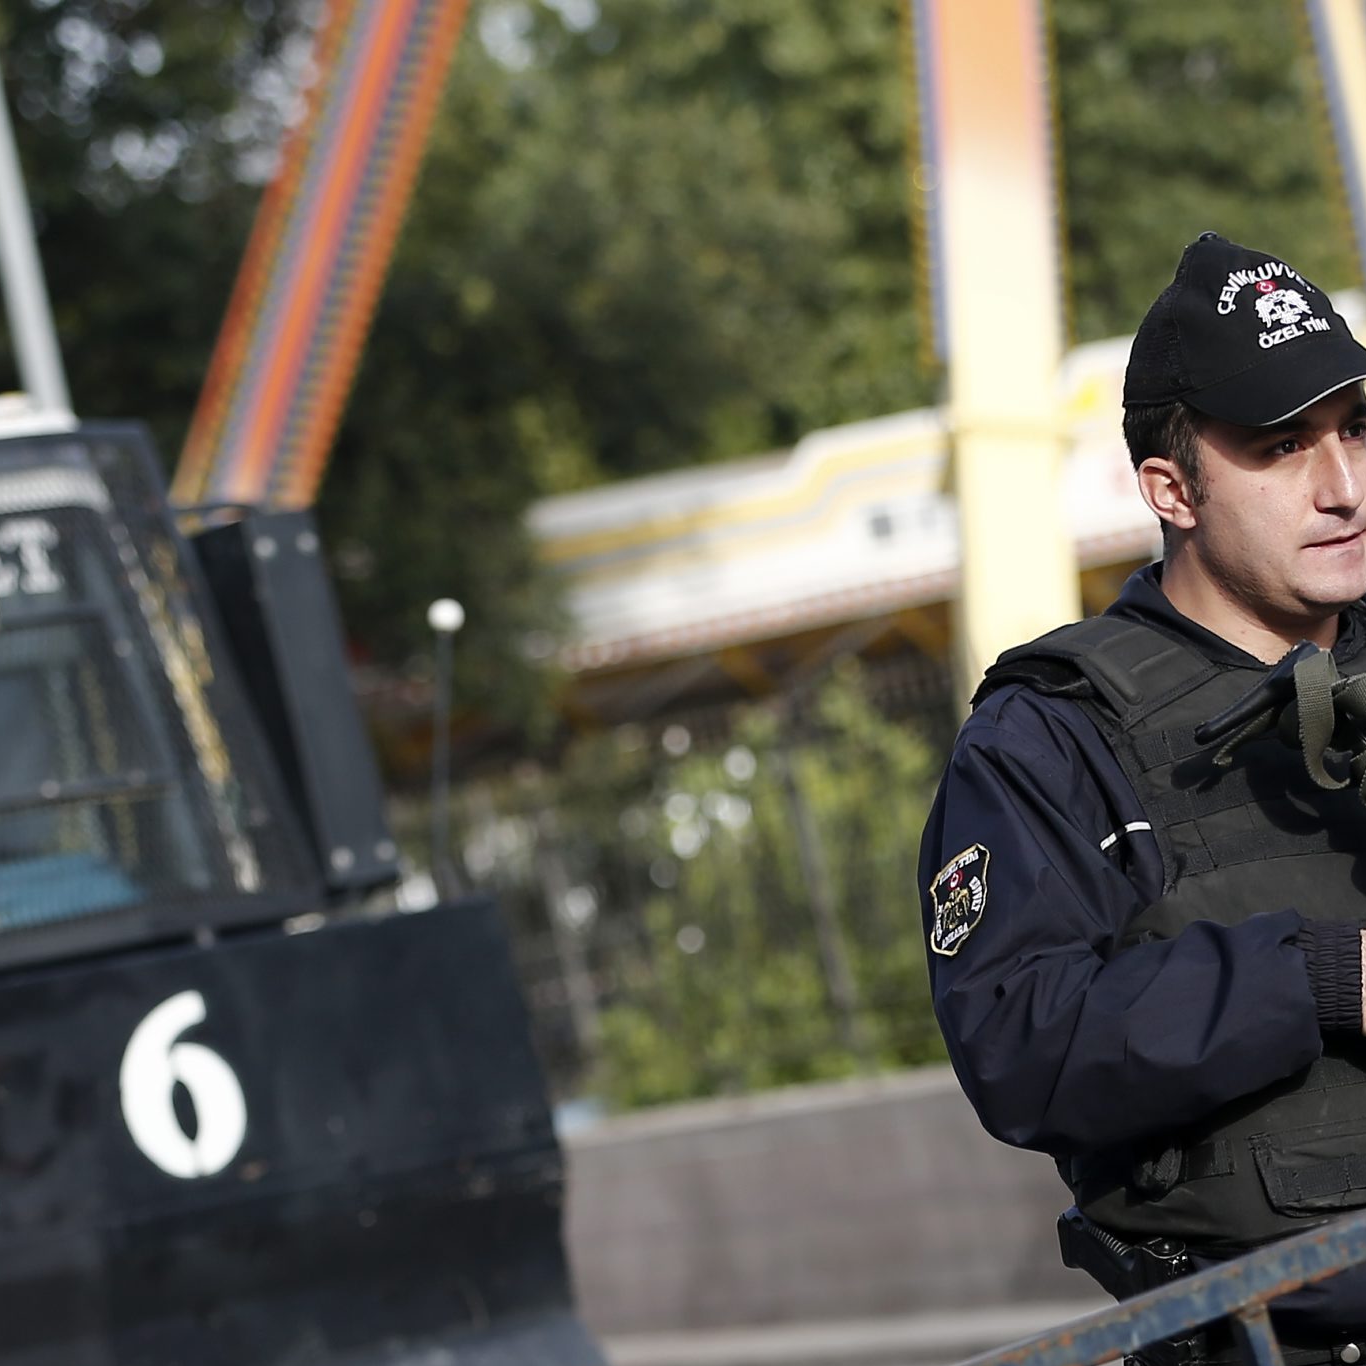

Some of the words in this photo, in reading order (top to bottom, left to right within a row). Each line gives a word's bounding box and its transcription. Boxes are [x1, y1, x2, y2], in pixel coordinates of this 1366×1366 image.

[1247, 262, 1316, 293] KUVV
[1258, 324, 1305, 349] ÖZEL
[1301, 316, 1331, 333] TİM
[119, 990, 247, 1179] 6
